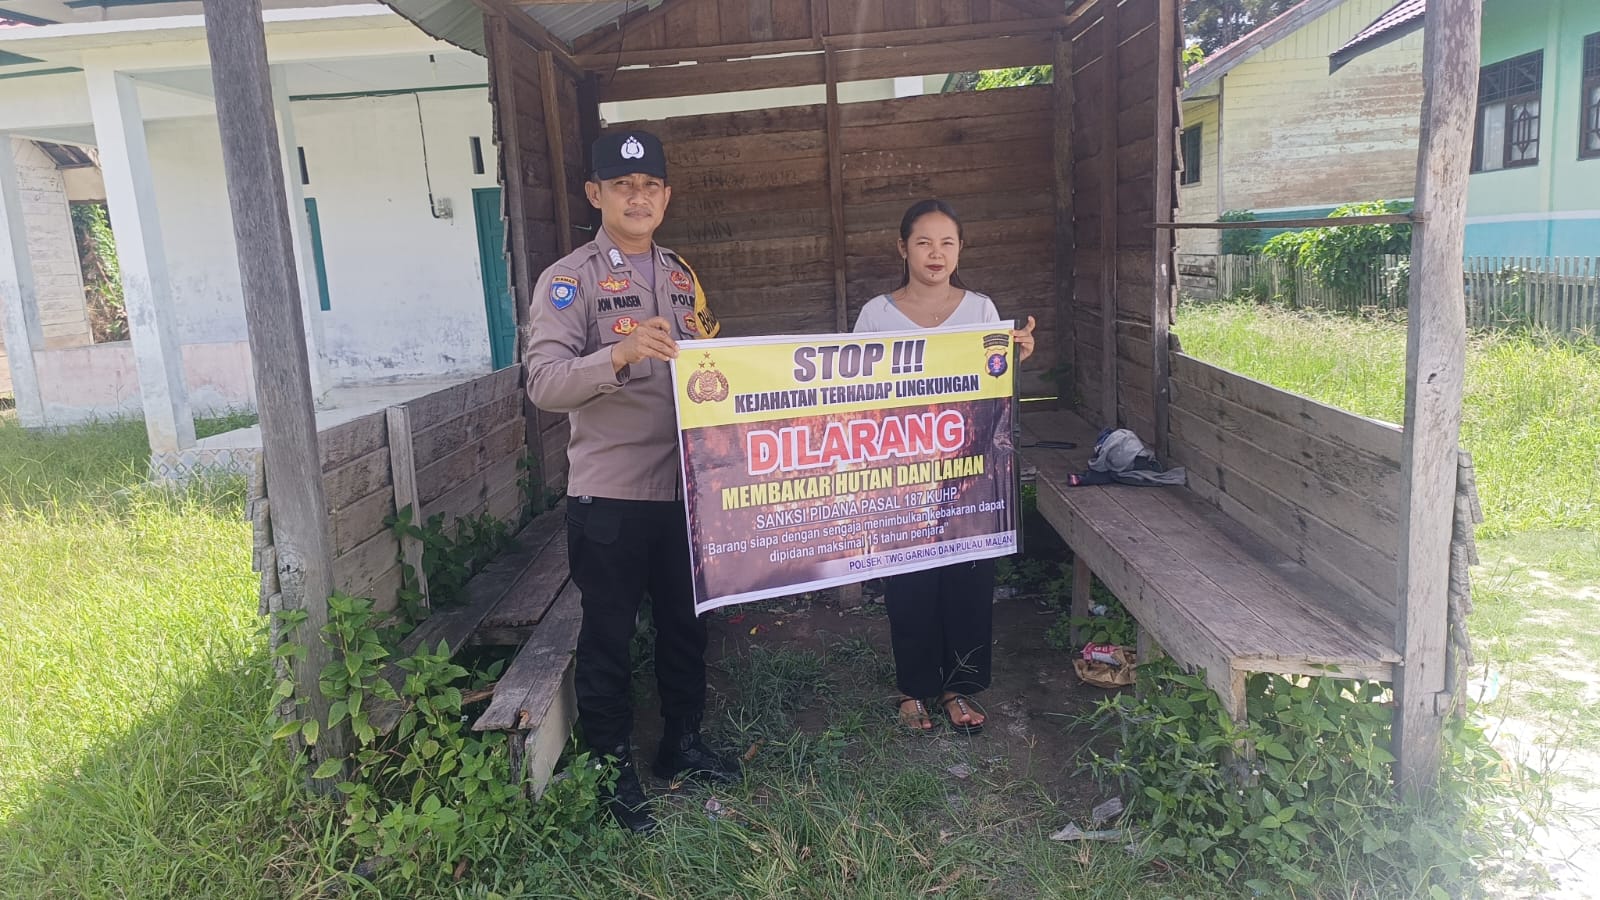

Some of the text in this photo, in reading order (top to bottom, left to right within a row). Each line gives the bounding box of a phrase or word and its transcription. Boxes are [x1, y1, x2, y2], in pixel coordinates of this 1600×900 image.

[597, 296, 612, 312] JON
[793, 343, 885, 382] STOP
[734, 374, 980, 414] KEJAHATAN TERHADAP LINGKUNGAN
[749, 411, 964, 474] DILARANG
[721, 454, 985, 511] MEMBAKAR HUTAN DAN LAHAN
[750, 535, 779, 549] siapa
[781, 529, 820, 544] dengan
[823, 521, 862, 537] sengaja
[864, 510, 928, 531] menimbulkan
[929, 503, 977, 520] kebakaran
[978, 499, 1005, 514] dapat
[756, 486, 958, 529] SANKSI PIDANA PASAL 187 KUHP
[769, 546, 815, 564] dipidana
[817, 535, 866, 554] maksimal
[868, 534, 879, 546] 15
[881, 530, 909, 544] tahun
[848, 534, 1013, 571] POLSEK TWG GARING DAN PULAU MALAN
